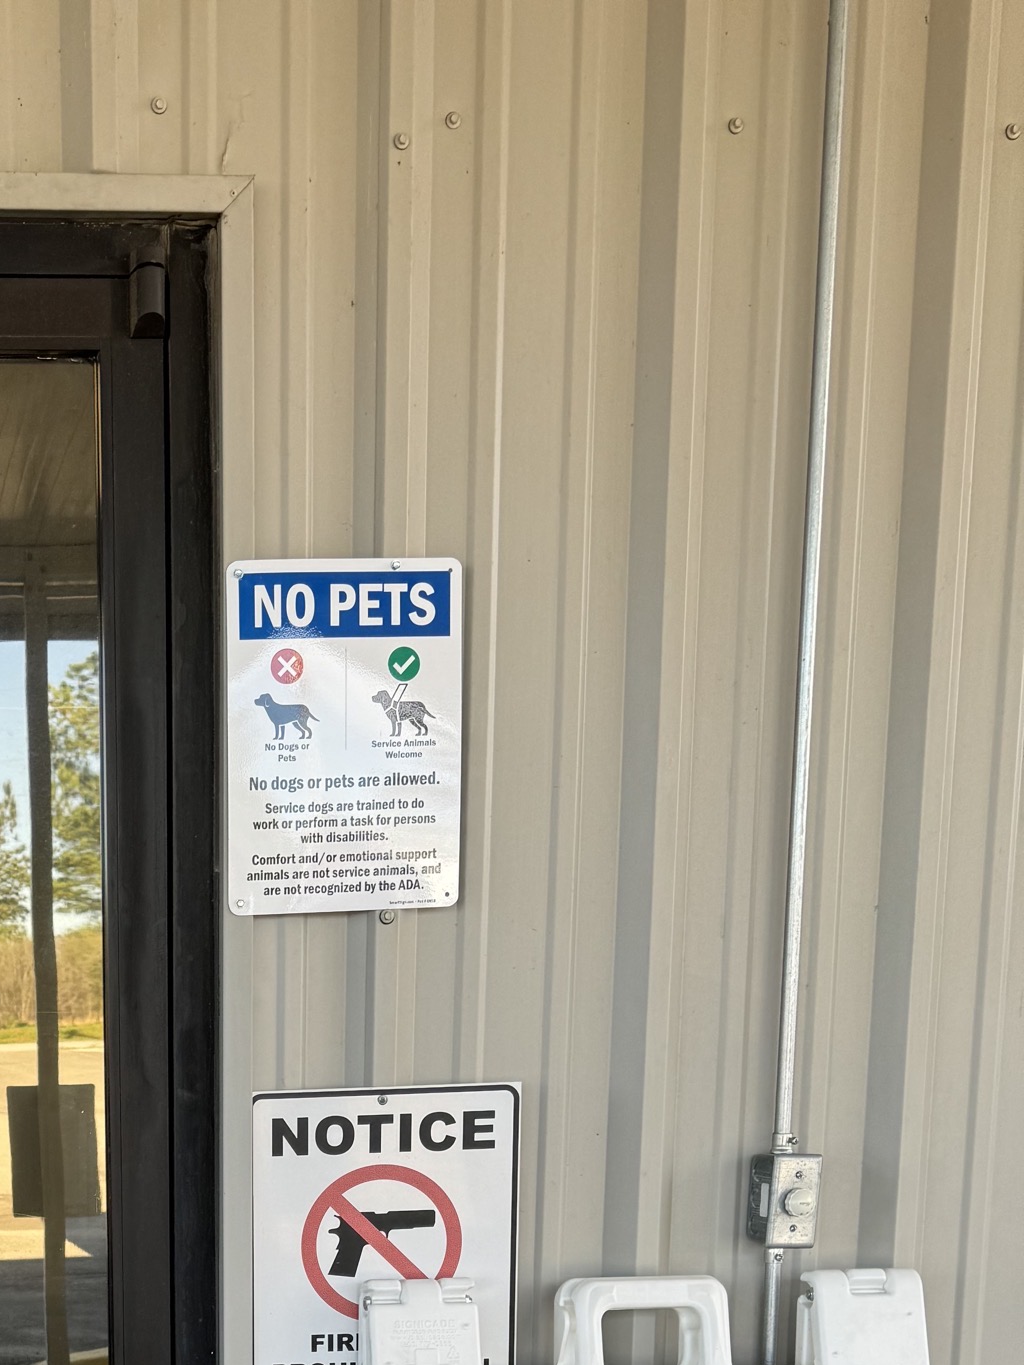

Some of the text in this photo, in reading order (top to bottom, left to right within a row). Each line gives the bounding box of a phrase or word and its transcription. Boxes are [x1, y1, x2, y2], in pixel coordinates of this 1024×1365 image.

[254, 582, 436, 629] NO PETS
[278, 743, 299, 752] Dogs
[372, 739, 436, 748] Service Animals
[250, 771, 440, 793] No dogs or pets are allowed.
[265, 798, 424, 814] Service dogs are trained to do
[253, 814, 436, 831] work or perform a task for persons
[301, 830, 388, 843] with disabilities.
[252, 848, 437, 865] Comfort and/or emotional support
[247, 862, 441, 881] animals are not service animals, and
[264, 879, 424, 896] are not recognized by the ADA.
[271, 1110, 496, 1156] NOTICE
